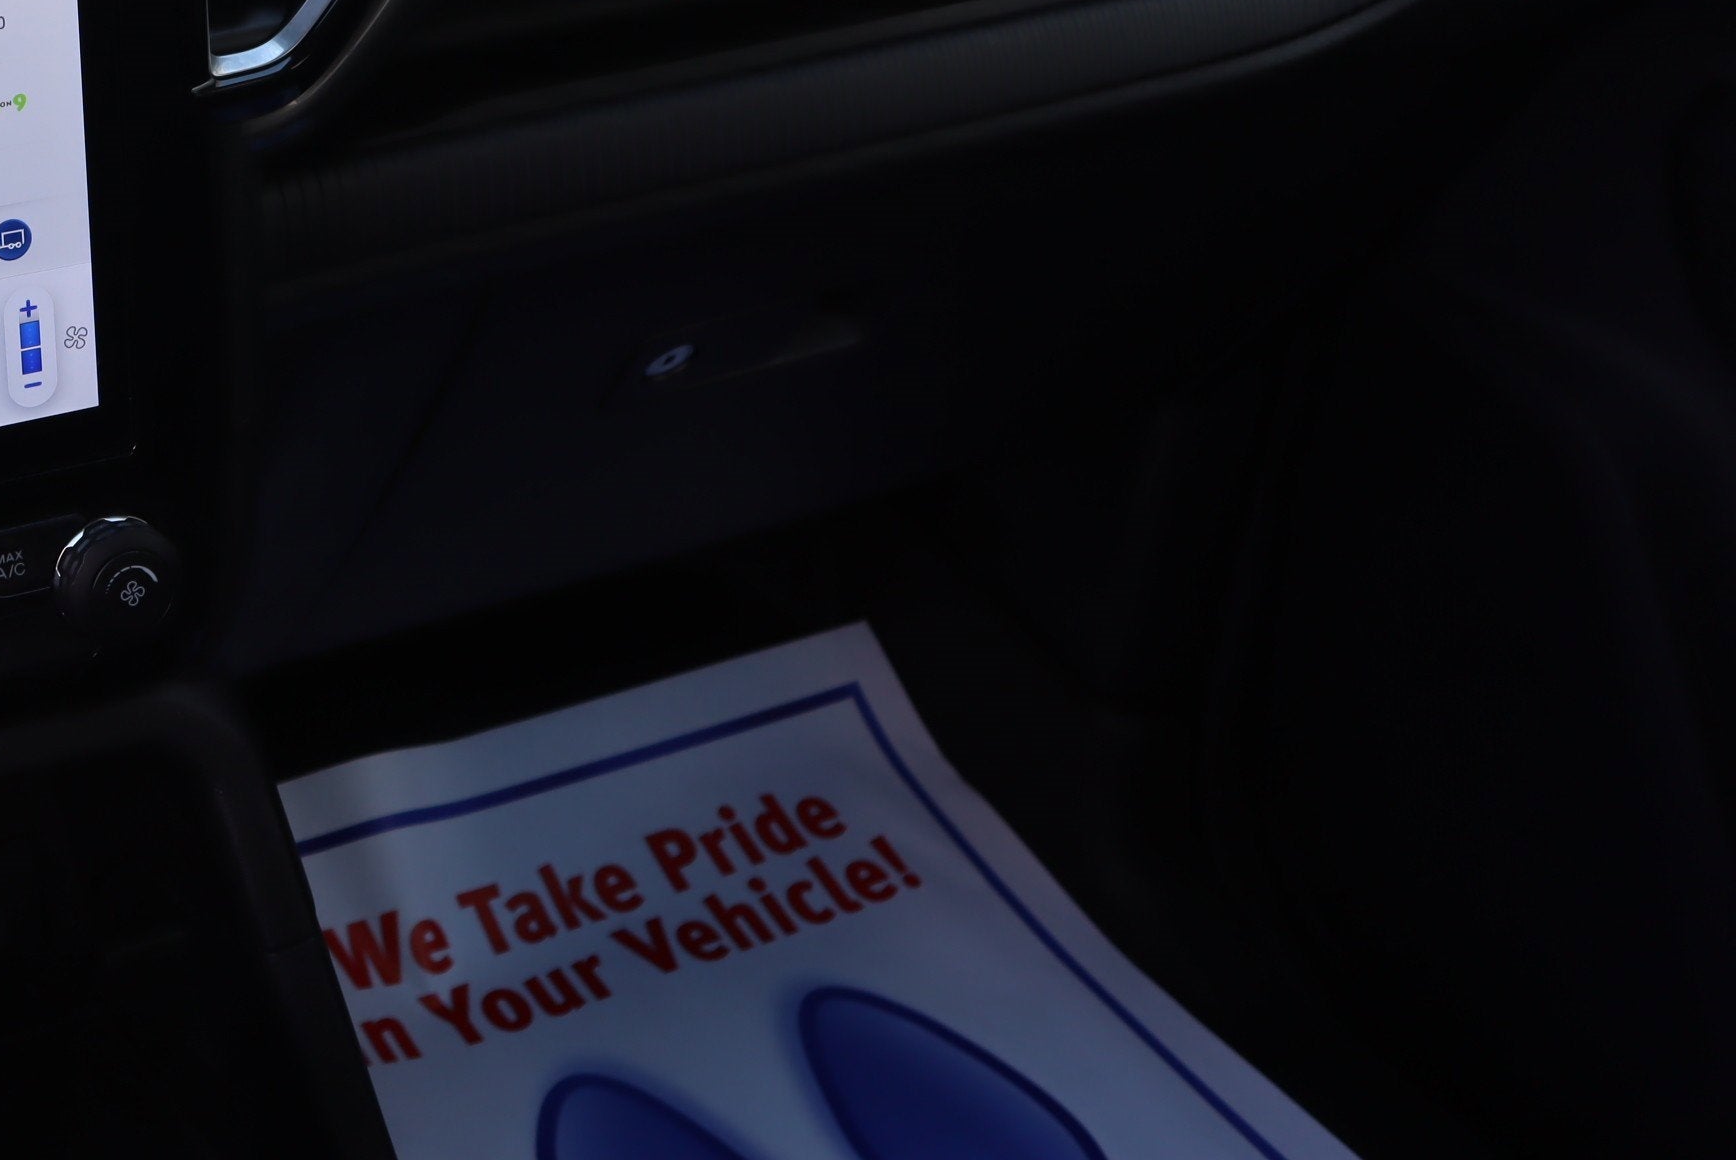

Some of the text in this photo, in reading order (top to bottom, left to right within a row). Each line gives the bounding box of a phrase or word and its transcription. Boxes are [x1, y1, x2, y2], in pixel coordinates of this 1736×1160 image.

[322, 793, 848, 989] We Take Pride
[361, 834, 922, 1066] n Your Vehicle!
